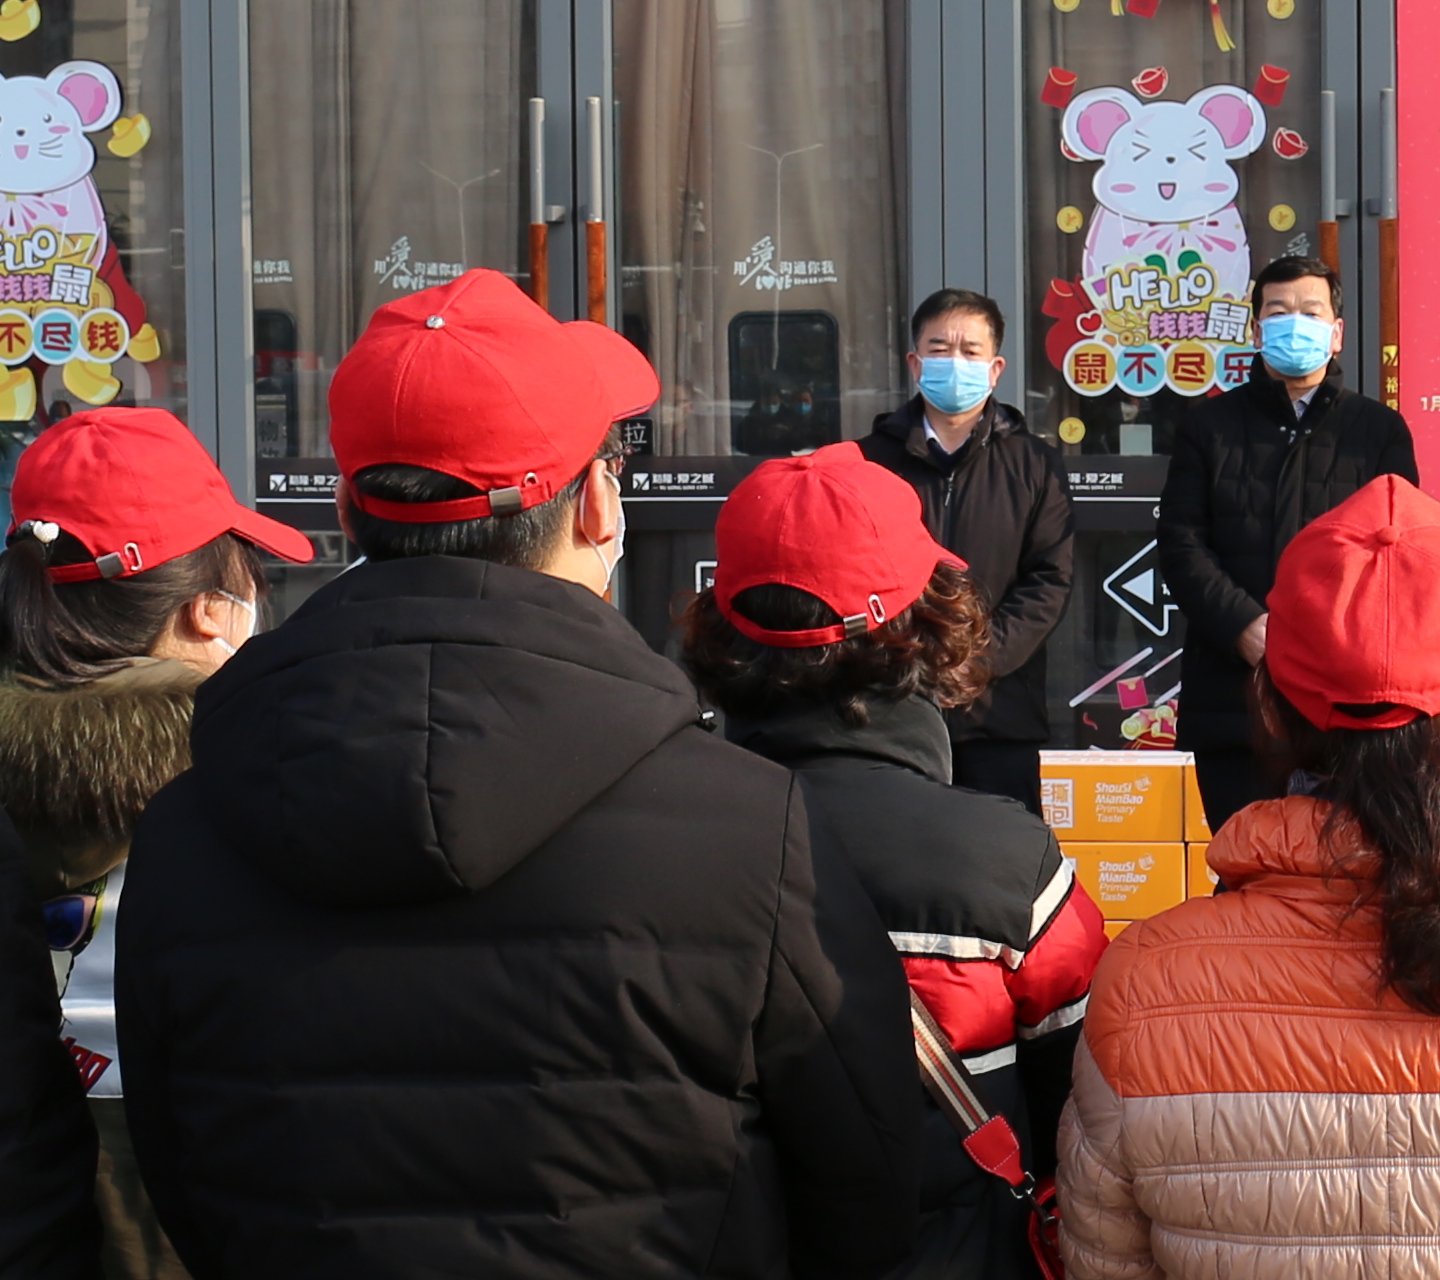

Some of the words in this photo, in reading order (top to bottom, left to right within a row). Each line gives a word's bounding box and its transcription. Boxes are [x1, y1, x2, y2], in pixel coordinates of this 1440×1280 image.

[1109, 267, 1215, 311] HELLO
[1072, 350, 1255, 385] 鼠不尽乐
[624, 422, 648, 444] 拉
